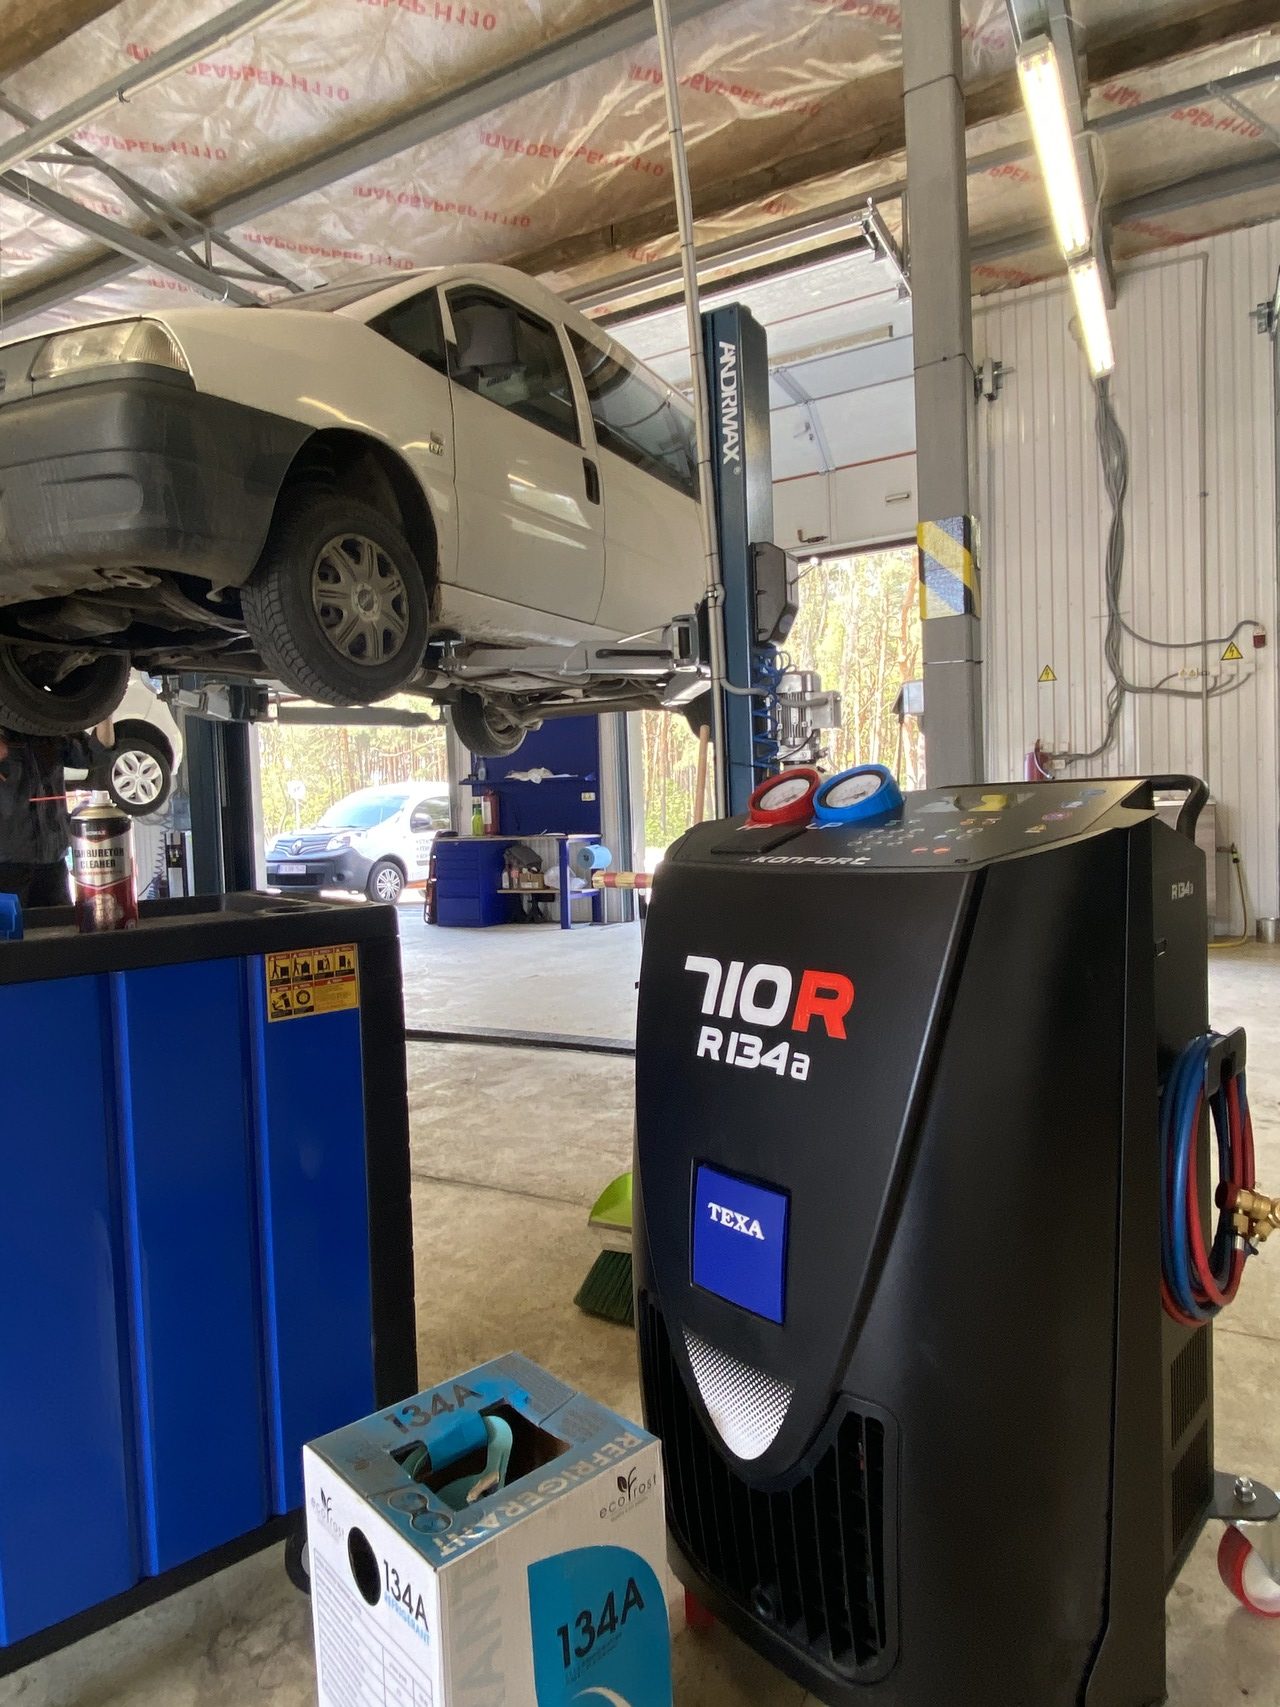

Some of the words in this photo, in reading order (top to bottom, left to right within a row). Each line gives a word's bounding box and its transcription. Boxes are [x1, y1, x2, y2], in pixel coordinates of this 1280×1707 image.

[719, 341, 740, 465] ANDRMAX
[806, 822, 845, 830] LP
[684, 955, 855, 1040] 710R
[707, 1201, 765, 1241] TEXA
[383, 1384, 483, 1433] 134A
[383, 1559, 429, 1632] 134A
[556, 1576, 645, 1668] 134A
